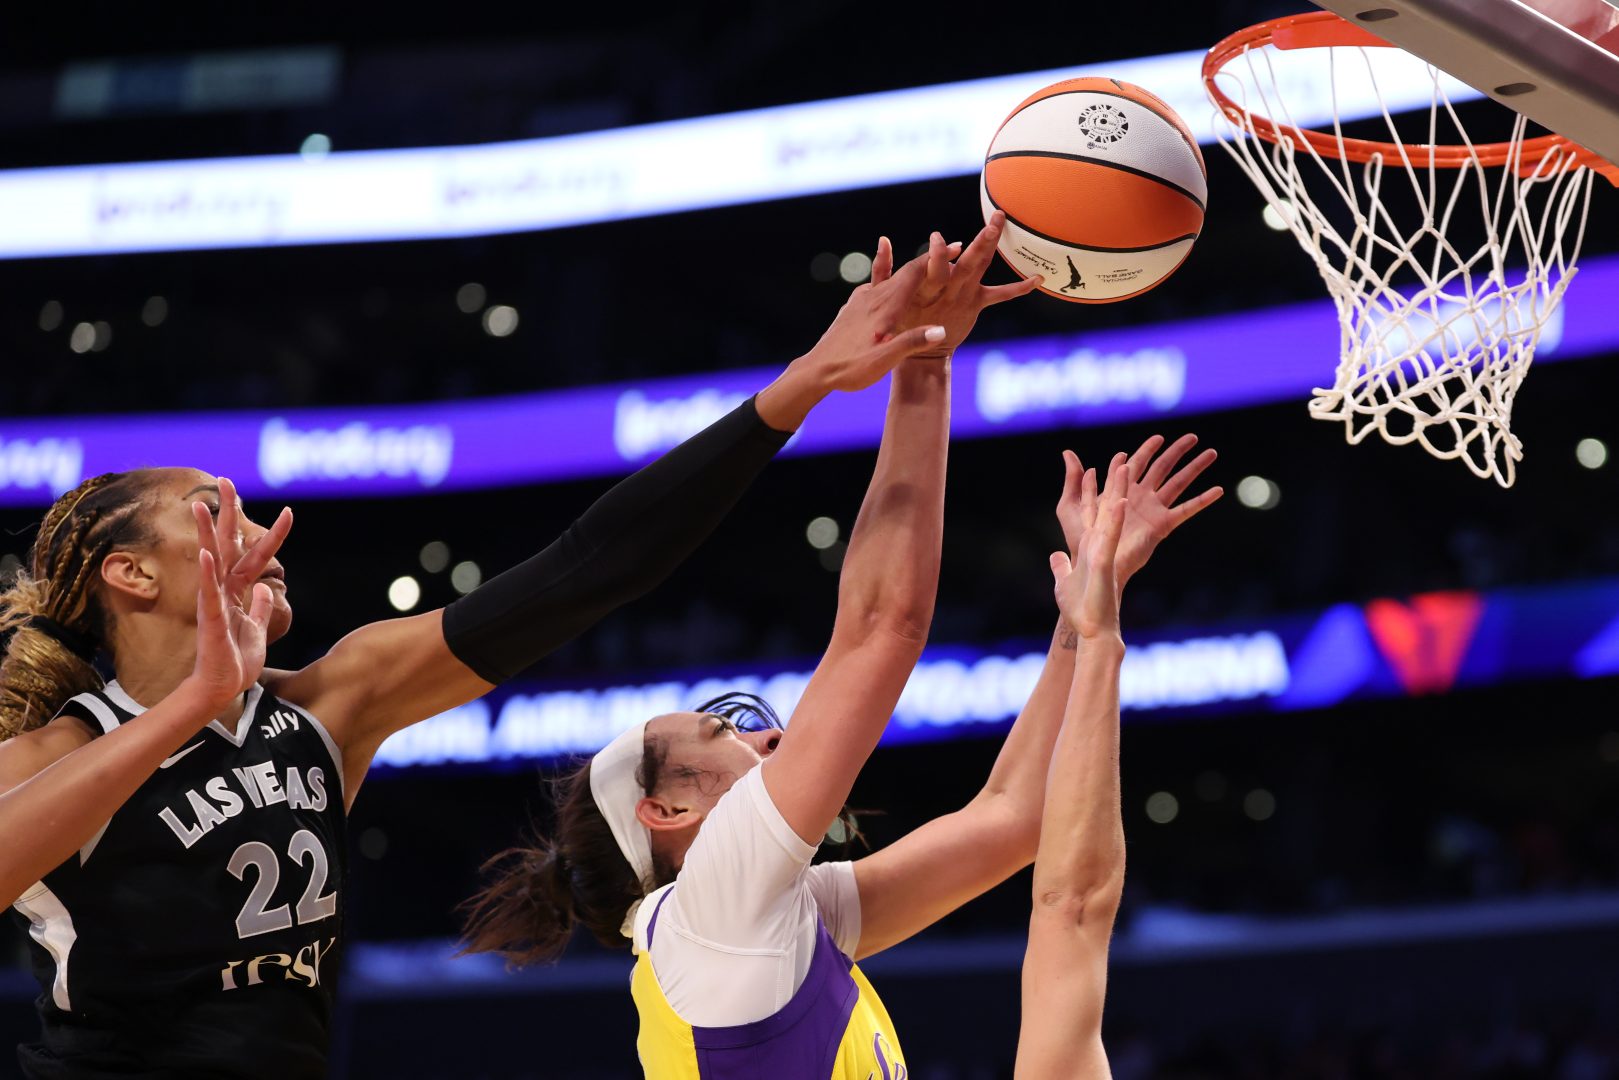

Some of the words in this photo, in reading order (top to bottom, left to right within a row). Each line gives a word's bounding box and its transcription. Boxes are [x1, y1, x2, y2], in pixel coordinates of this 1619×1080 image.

[1119, 269, 1144, 278] GAME
[261, 710, 300, 739] ally
[158, 776, 244, 849] LAS
[232, 760, 328, 813] VEAS
[226, 829, 337, 940] 22
[221, 936, 336, 991] IPSY
